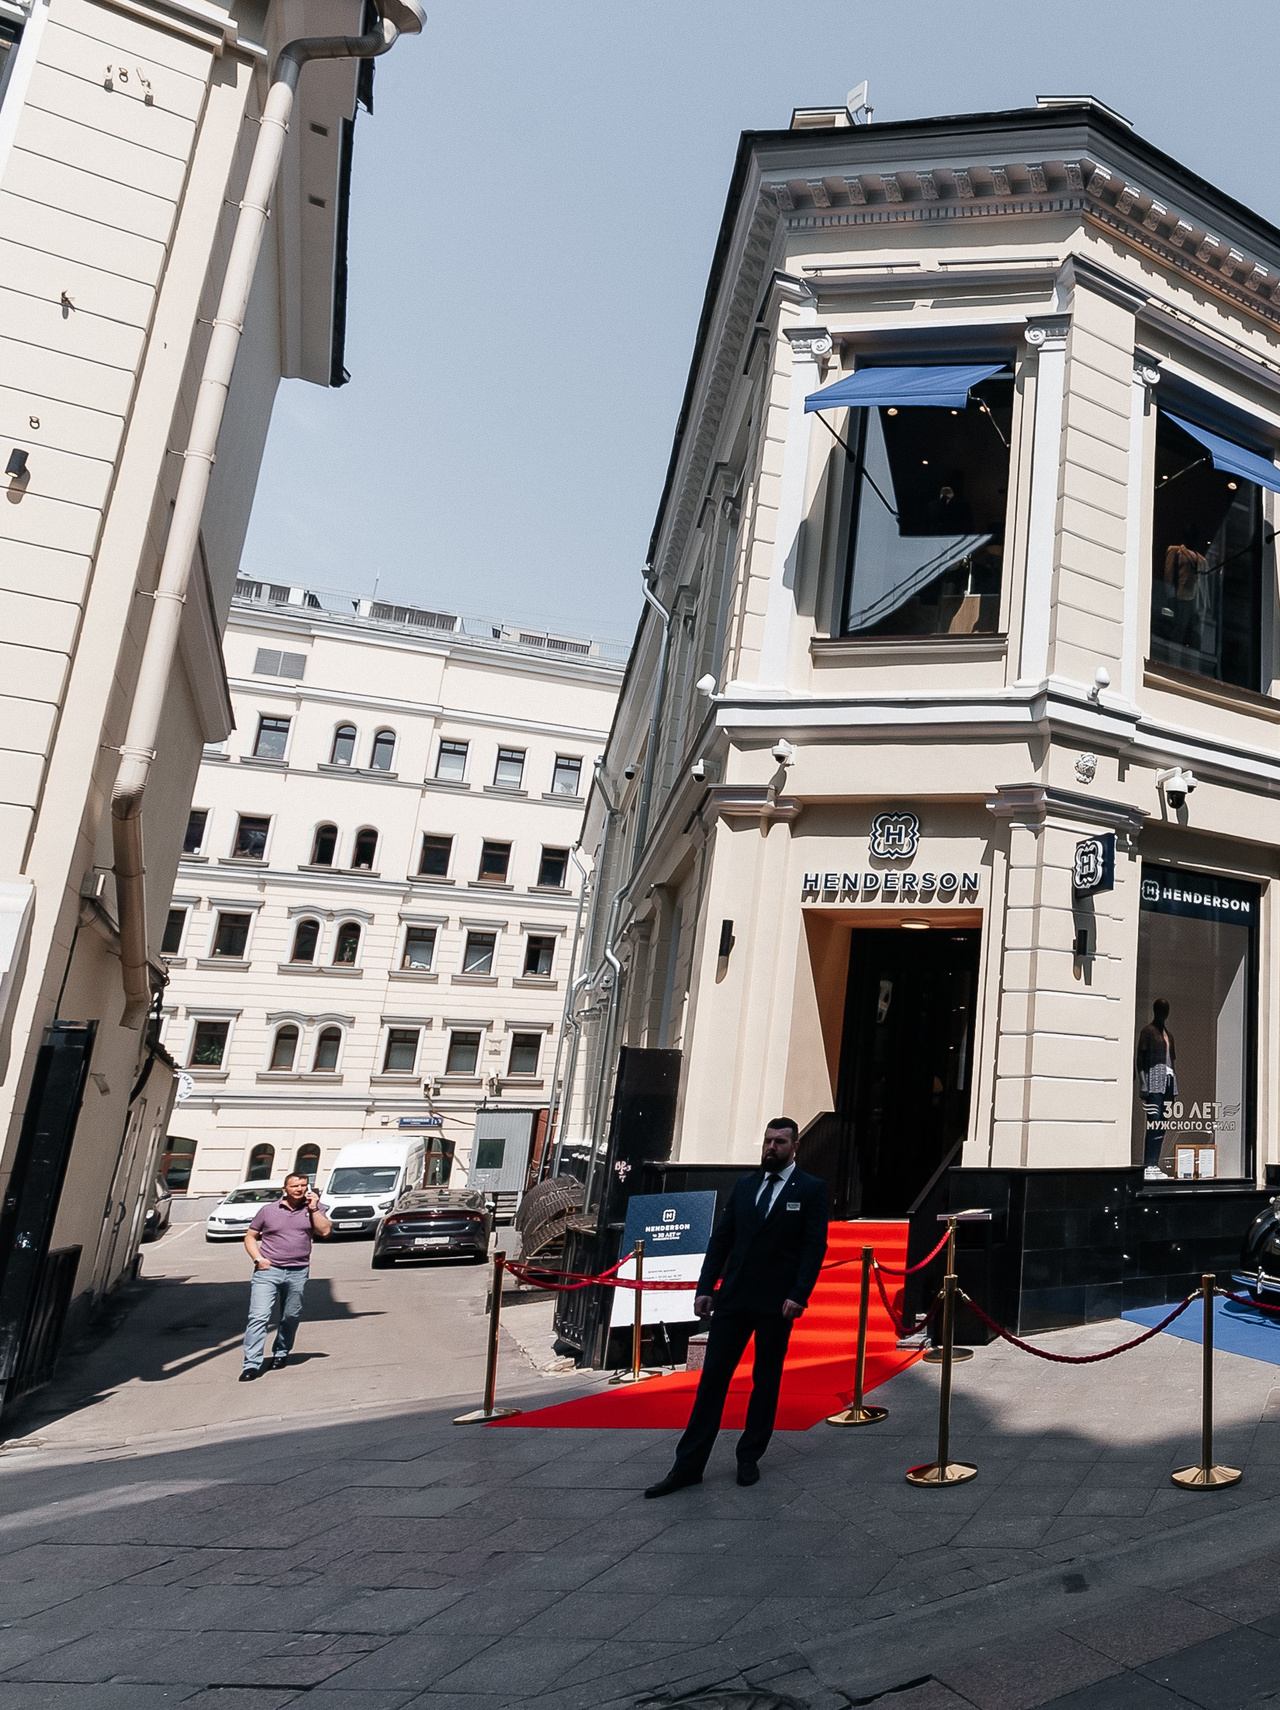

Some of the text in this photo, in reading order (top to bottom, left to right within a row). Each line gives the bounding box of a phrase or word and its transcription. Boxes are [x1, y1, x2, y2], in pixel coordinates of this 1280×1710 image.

[802, 872, 981, 891] HENDERSON
[1163, 888, 1250, 912] HENDERSON
[1162, 1100, 1222, 1119] 30 ЛЕТ
[1146, 1120, 1236, 1131] МУЖСКОГО СТИЛЯ
[645, 1224, 690, 1232] HENDERSON
